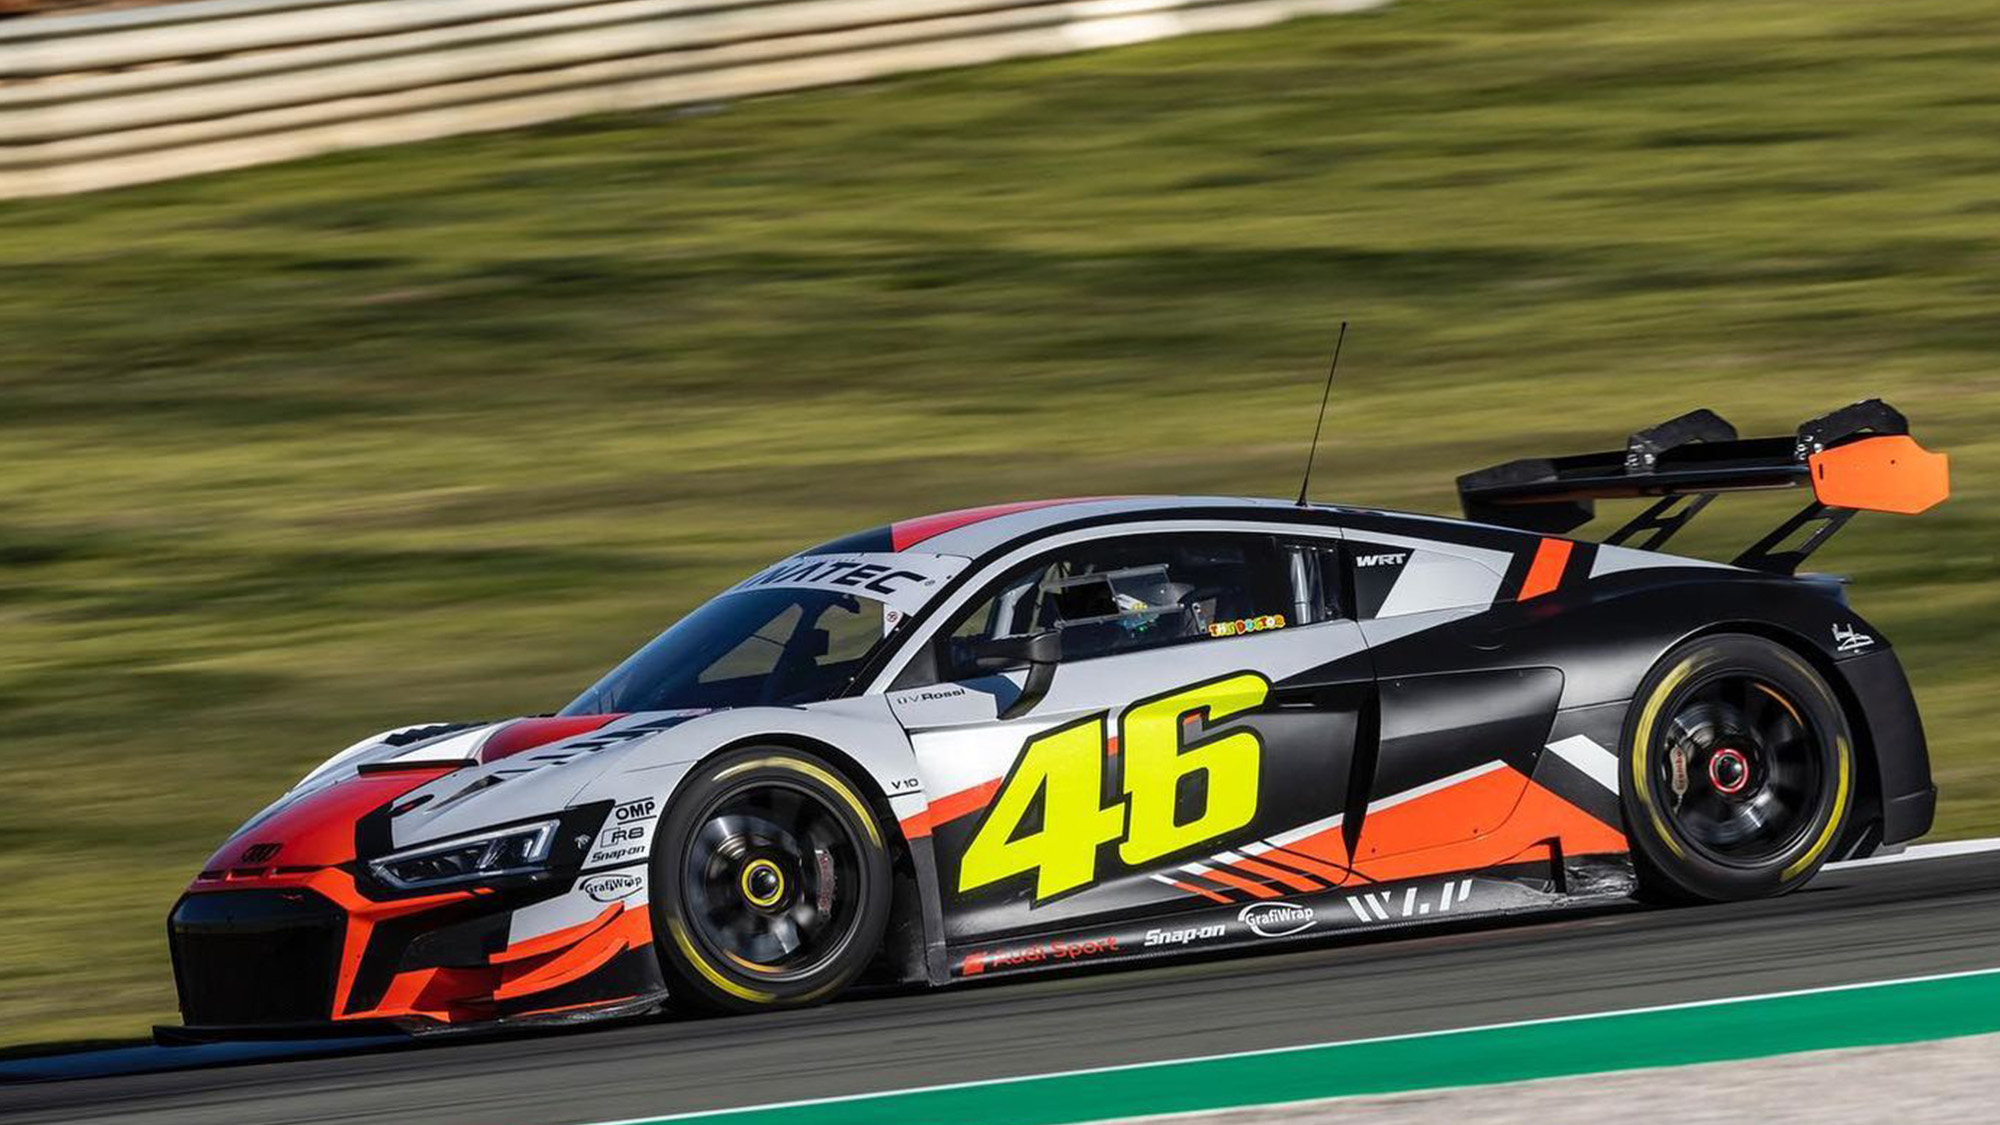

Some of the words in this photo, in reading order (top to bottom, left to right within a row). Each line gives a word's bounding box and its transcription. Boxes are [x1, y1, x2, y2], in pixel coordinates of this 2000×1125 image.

[1356, 552, 1406, 567] WRT
[1235, 614, 1286, 635] DOCTOR
[956, 671, 1270, 906] 46
[615, 801, 655, 820] OMP
[611, 827, 644, 842] R8
[592, 845, 646, 862] Snap-on
[585, 876, 642, 894] GrafiWrap
[1245, 906, 1314, 927] GrafiWrap
[1144, 924, 1226, 946] Snap-on
[993, 944, 1047, 966] Audi
[1050, 936, 1119, 960] Sport
